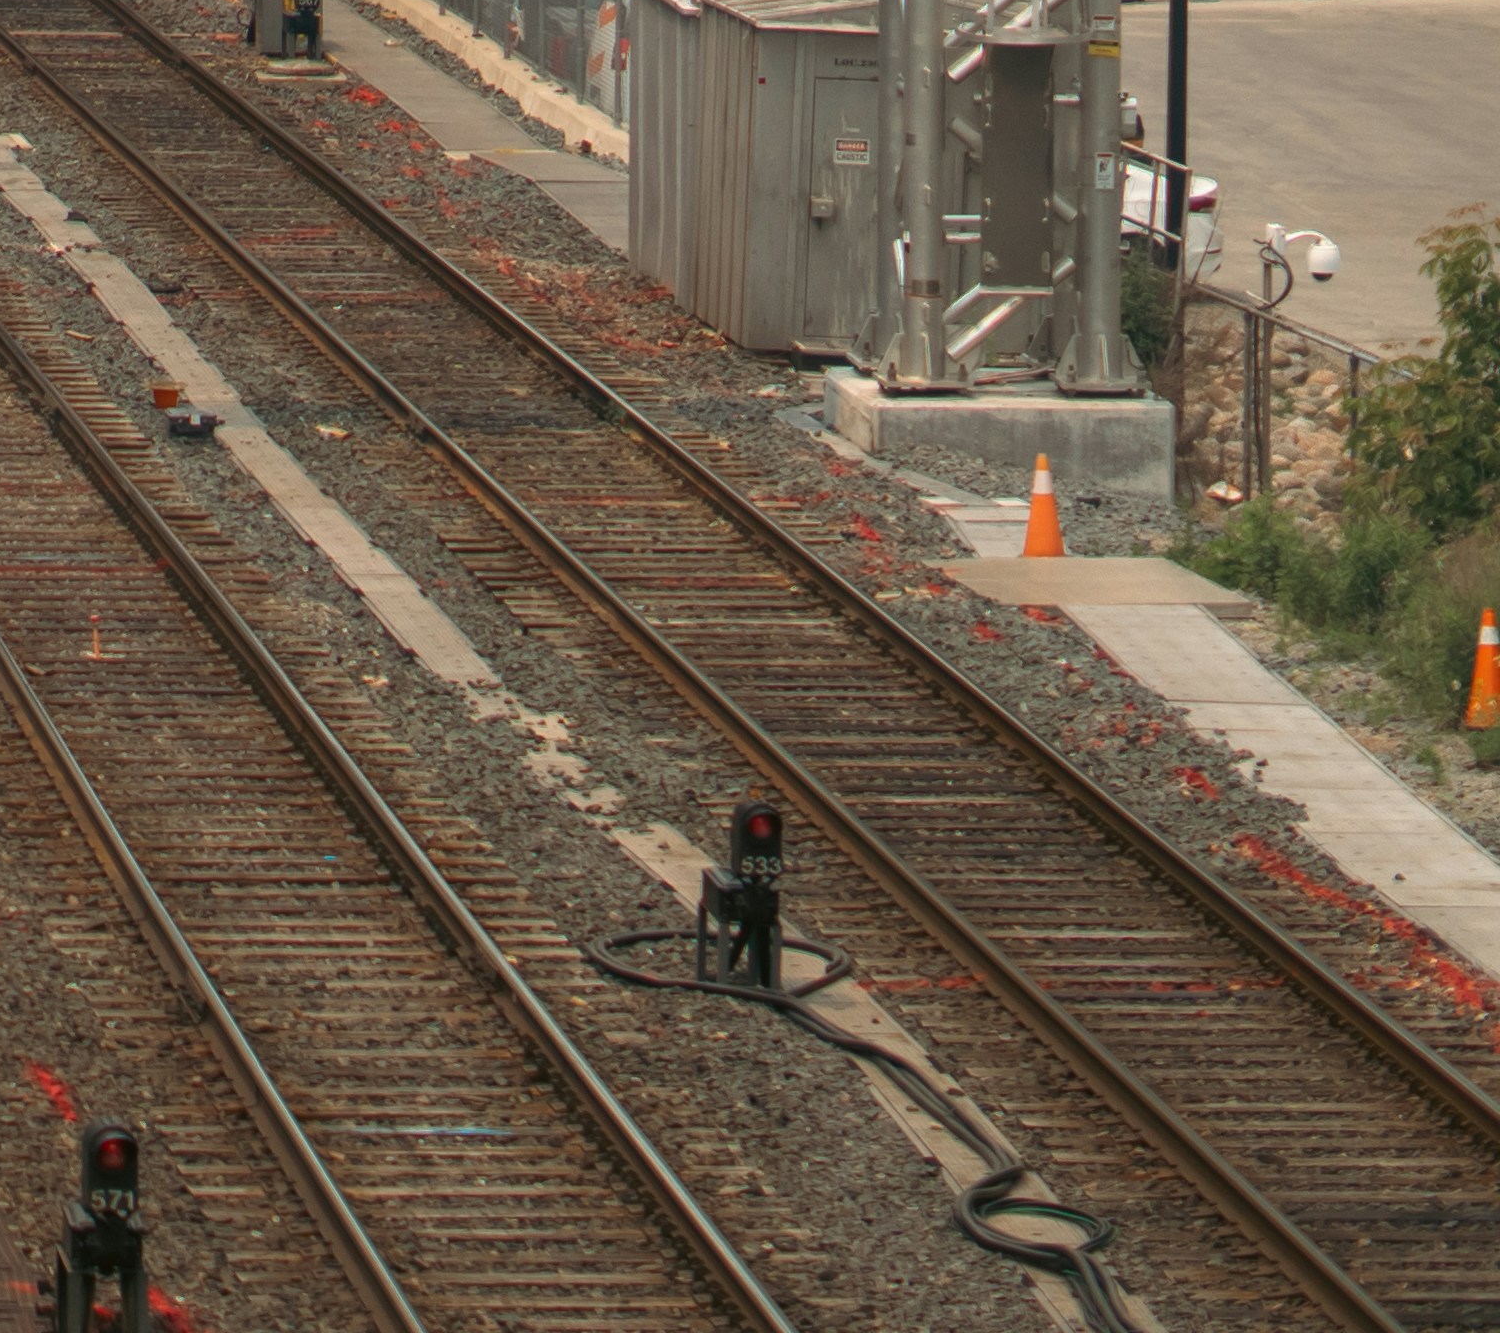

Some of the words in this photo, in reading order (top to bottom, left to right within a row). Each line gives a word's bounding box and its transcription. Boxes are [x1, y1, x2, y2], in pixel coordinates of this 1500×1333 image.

[836, 152, 868, 162] CAUSTIC
[741, 855, 781, 874] 533
[91, 1189, 134, 1211] 571
